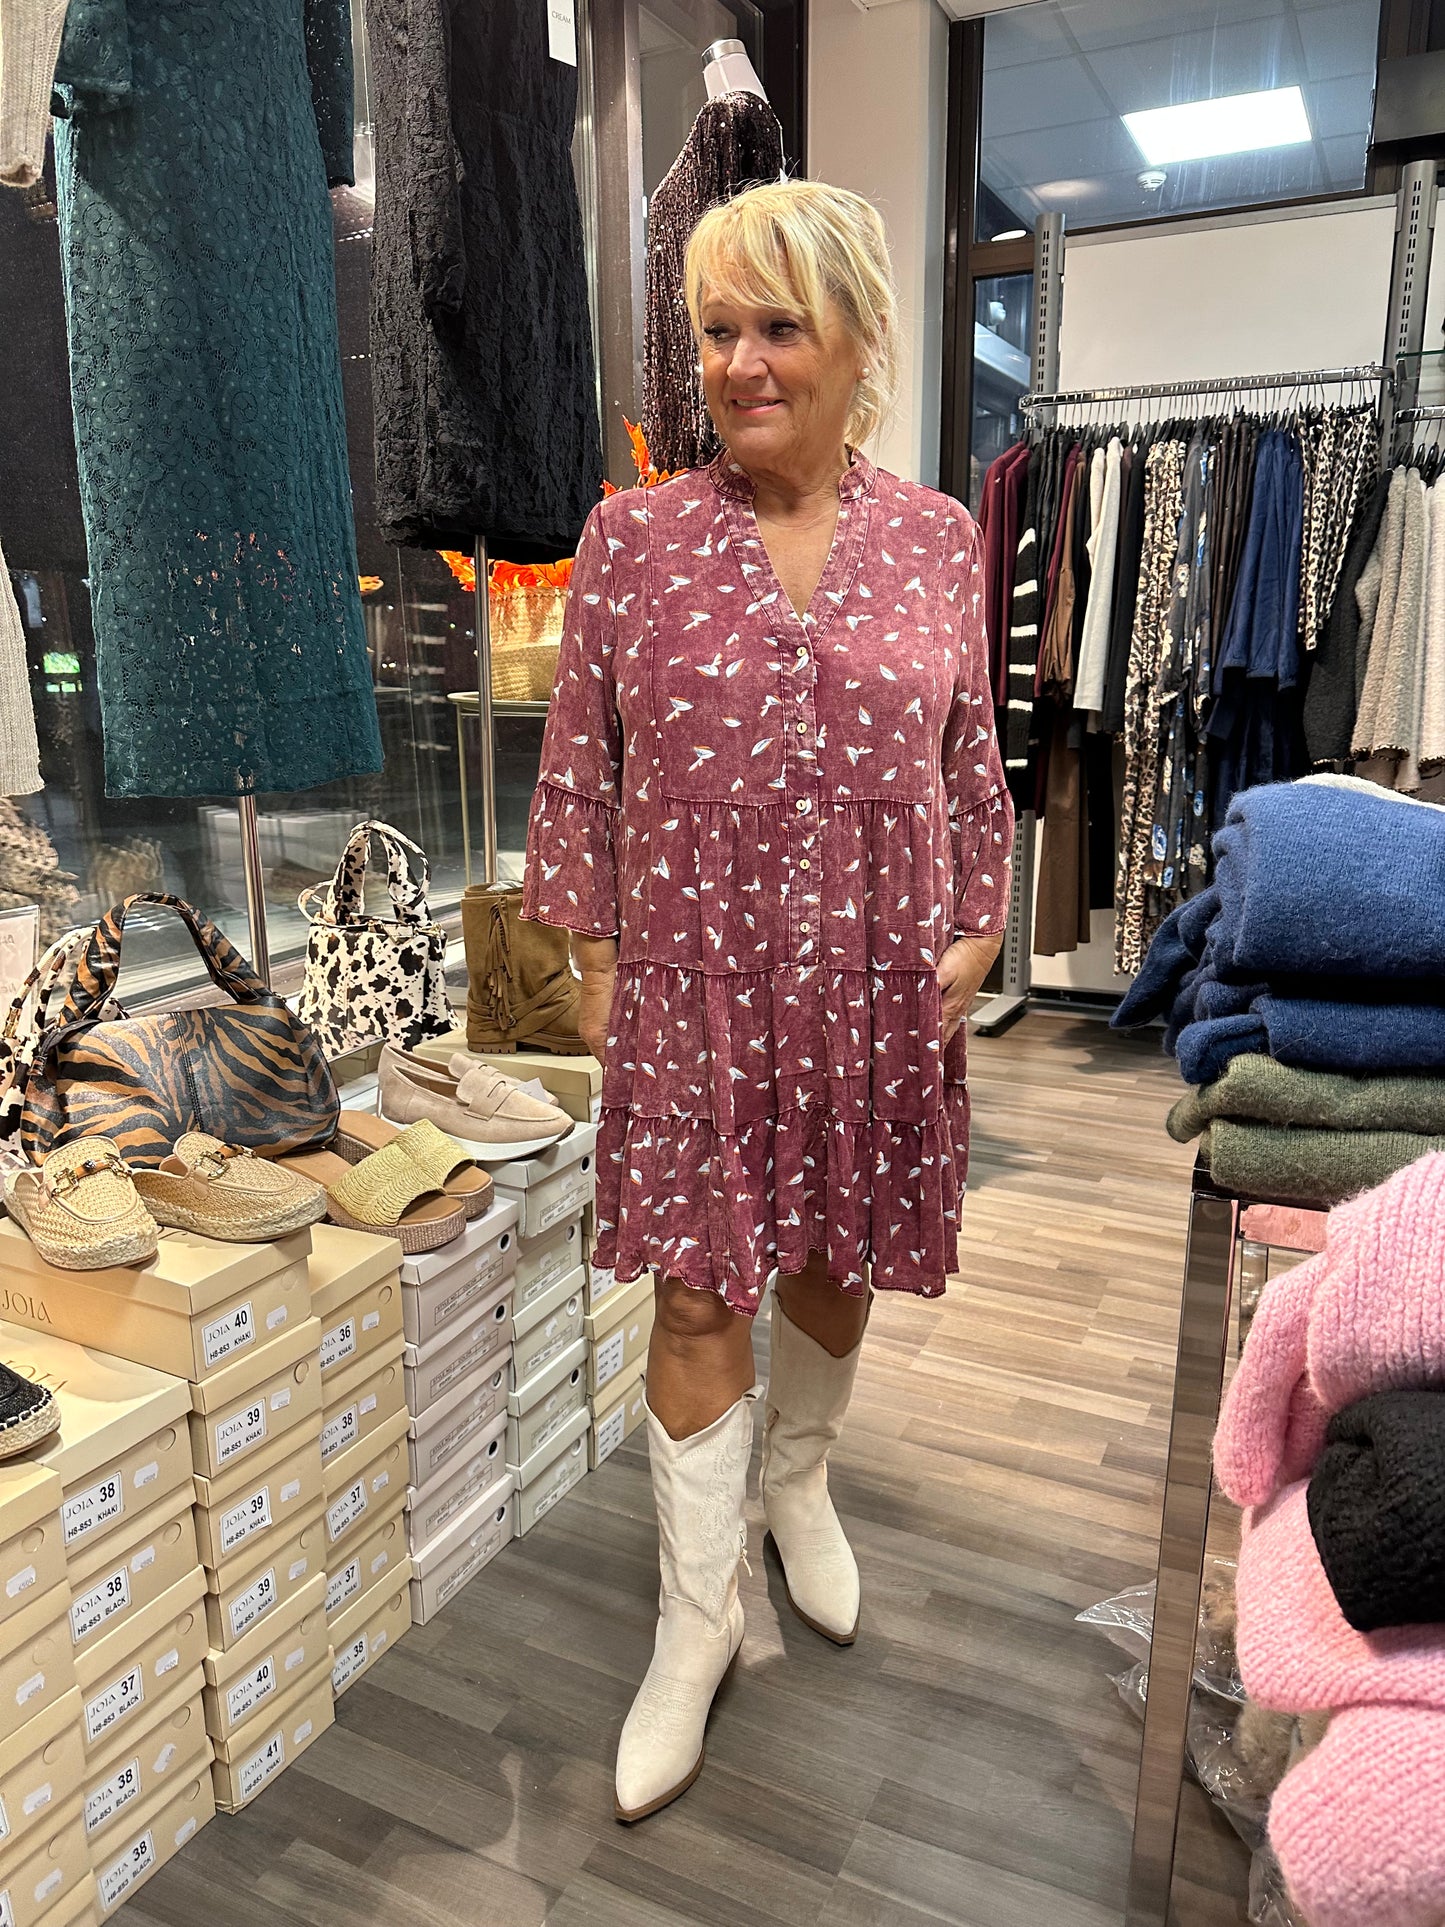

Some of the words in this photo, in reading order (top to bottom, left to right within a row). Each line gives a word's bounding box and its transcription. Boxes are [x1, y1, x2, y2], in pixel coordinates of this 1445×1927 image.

[552, 10, 571, 24] CREAM
[2, 1289, 52, 1324] JOIA
[208, 1324, 230, 1342] JOIA
[235, 1310, 247, 1327] 40
[340, 1325, 350, 1341] 36
[210, 1343, 230, 1360] H8-853
[234, 1331, 251, 1346] KHAKI
[220, 1422, 242, 1440] JOIA
[247, 1408, 260, 1426] 39
[245, 1428, 262, 1443] KHAKI
[342, 1412, 353, 1429] 38
[66, 1498, 94, 1519] JOIA
[100, 1482, 115, 1502] 38
[225, 1510, 247, 1529] JOIA
[251, 1495, 263, 1513] 39
[331, 1502, 349, 1522] JOIA
[351, 1486, 360, 1503] 37
[68, 1518, 92, 1538] H8-853
[97, 1504, 118, 1521] KHAKI
[249, 1514, 266, 1530] KHAKI
[345, 1565, 355, 1582] 37
[74, 1594, 102, 1618] JOIA
[106, 1576, 122, 1597] 38
[234, 1595, 255, 1616] JOIA
[258, 1578, 270, 1596] 39
[77, 1613, 101, 1636] H8-853
[105, 1596, 126, 1616] BLACK
[354, 1641, 363, 1657] 38
[90, 1694, 116, 1718] JOIA
[121, 1674, 135, 1696] 37
[231, 1682, 252, 1704] JOIA
[257, 1665, 268, 1682] 40
[119, 1694, 139, 1714] BLACK
[243, 1758, 263, 1780] JOIA
[267, 1740, 277, 1757] 41
[87, 1788, 113, 1812] JOIA
[117, 1768, 133, 1789] 38
[116, 1787, 136, 1807] BLACK
[104, 1862, 128, 1889] JOIA
[133, 1840, 147, 1861] 38
[132, 1856, 151, 1878] BLACK
